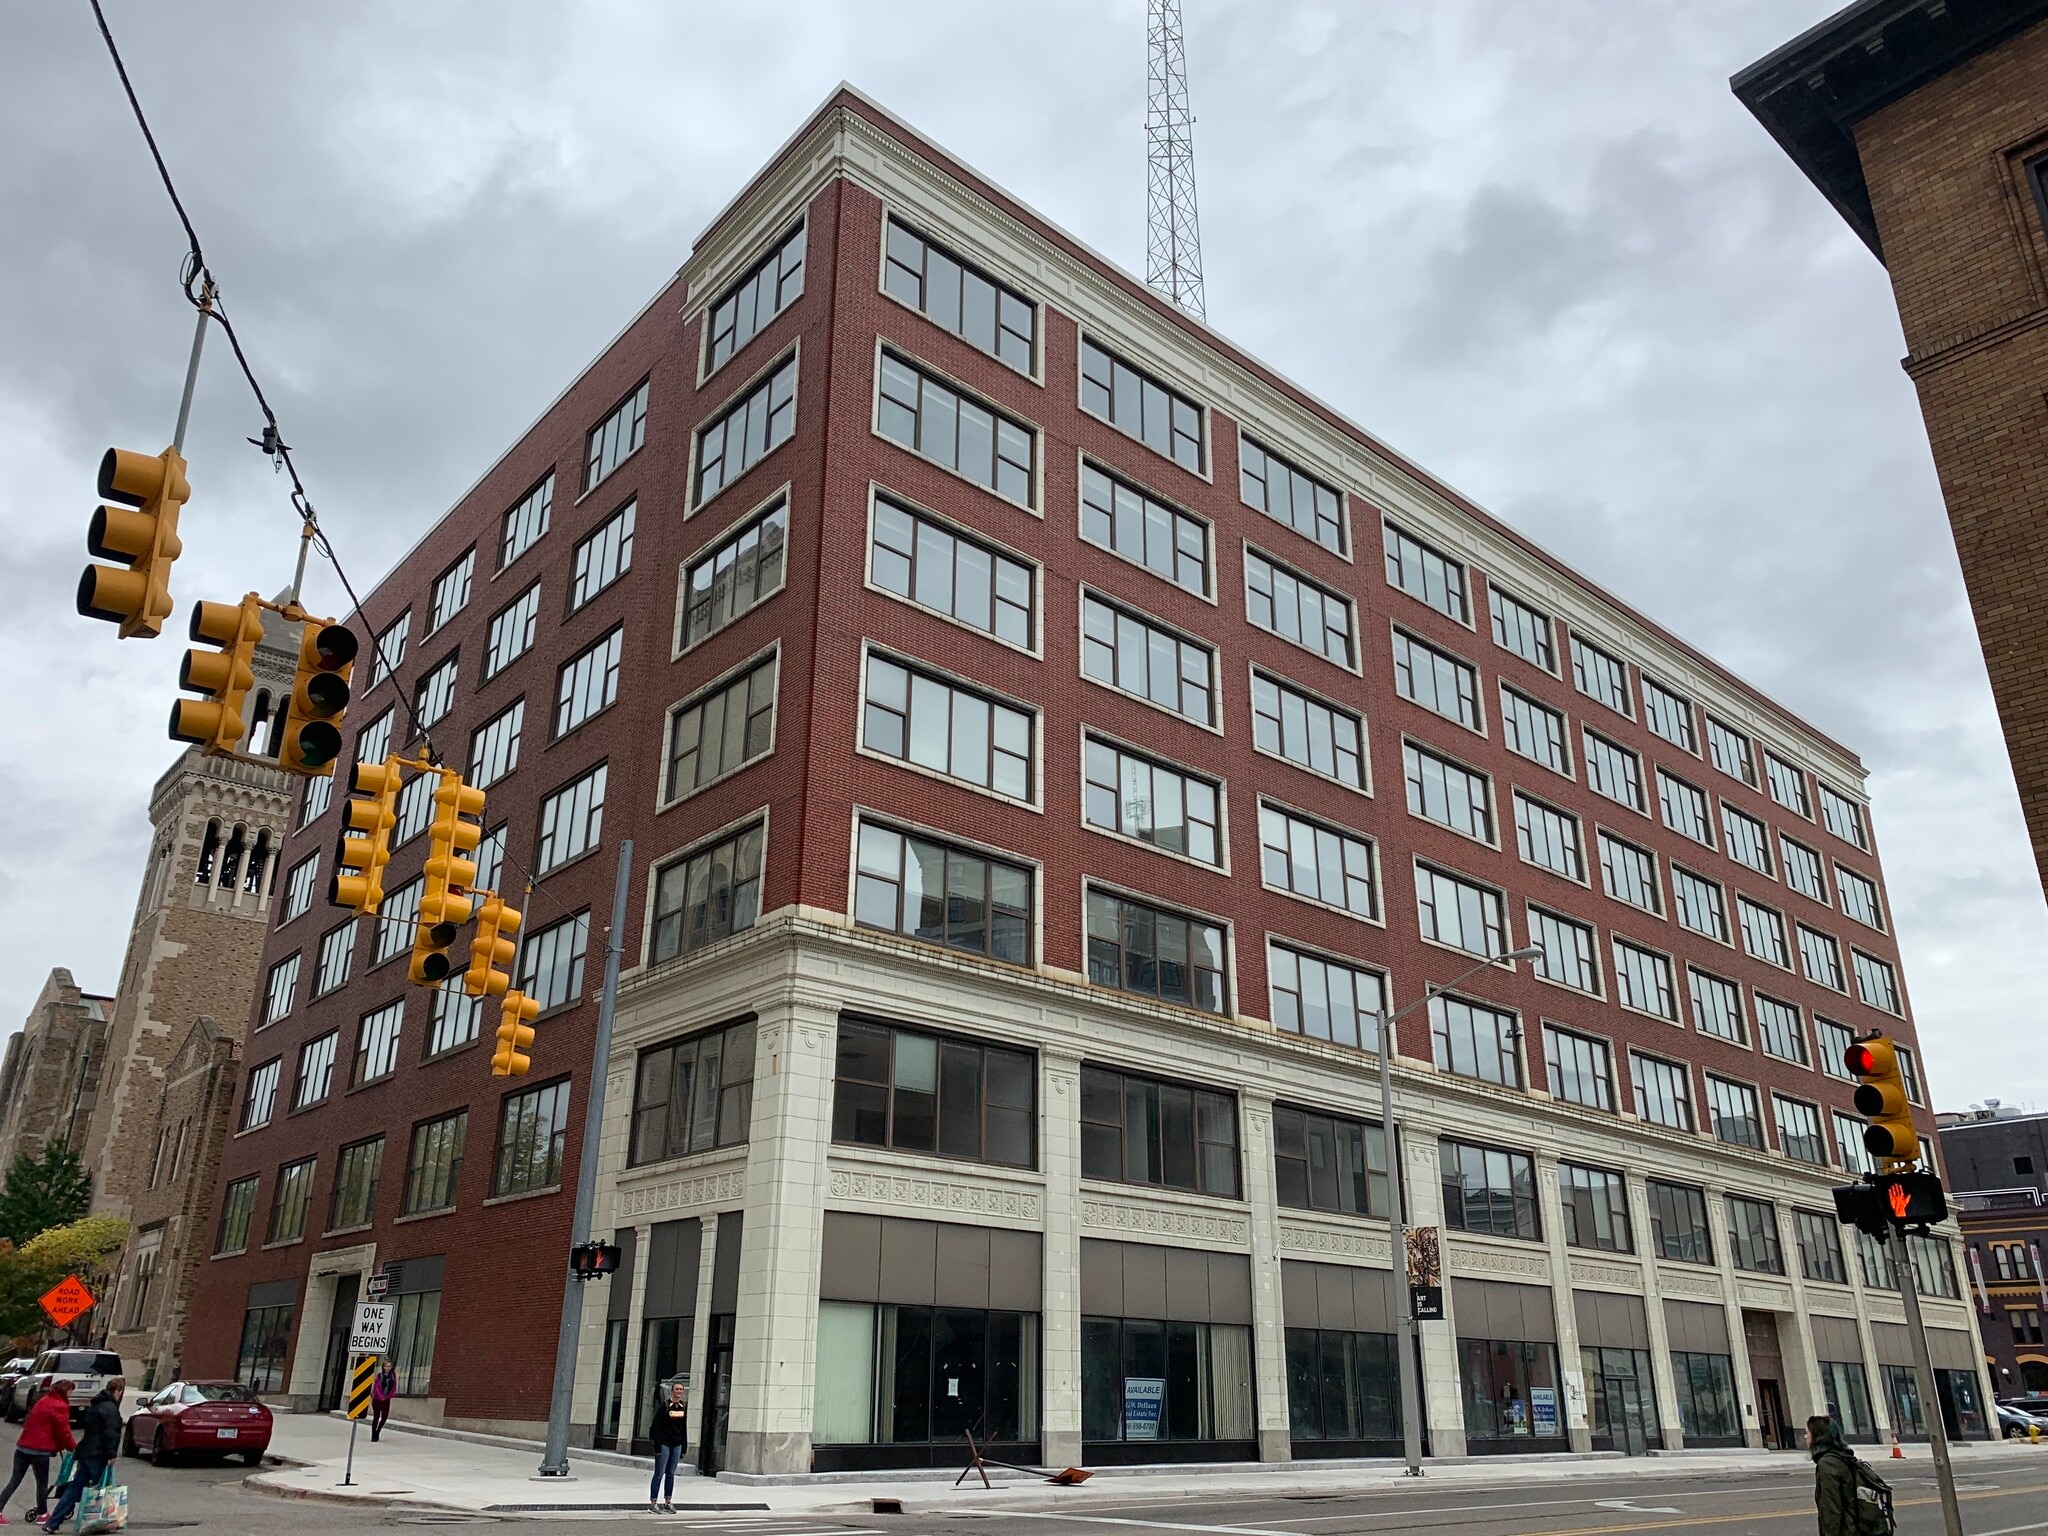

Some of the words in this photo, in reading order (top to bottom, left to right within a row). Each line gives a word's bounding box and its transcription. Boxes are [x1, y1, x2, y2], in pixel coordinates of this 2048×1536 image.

[52, 1306, 80, 1314] AHEAD
[363, 1307, 385, 1320] ONE
[361, 1322, 383, 1334] WAY
[352, 1336, 386, 1348] BEGINS
[1127, 1386, 1161, 1394] AVAILABLE
